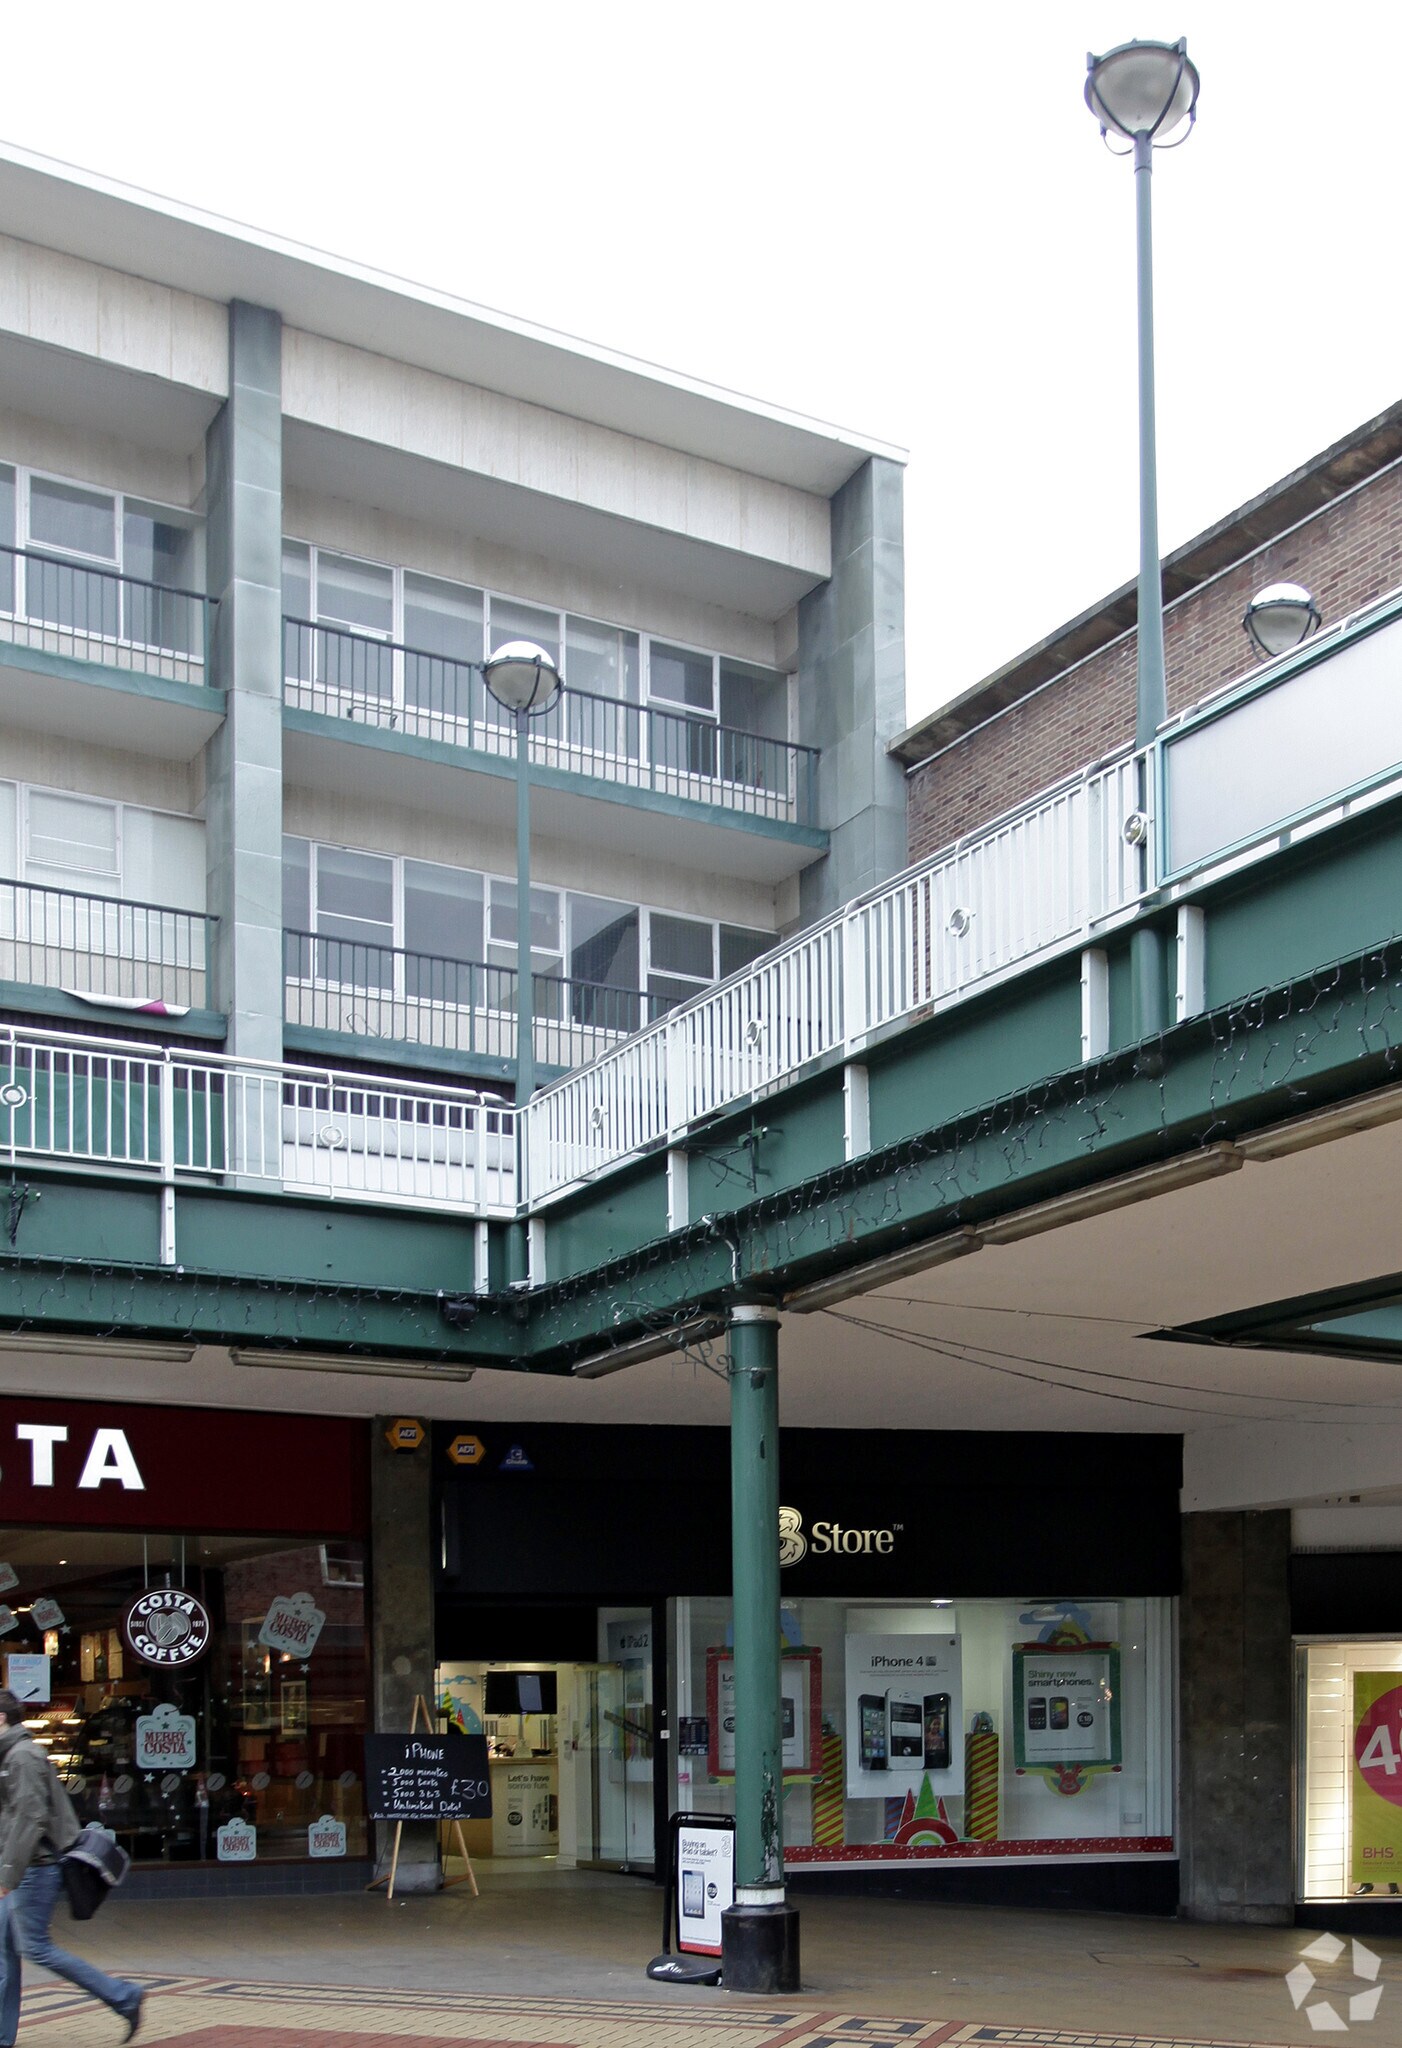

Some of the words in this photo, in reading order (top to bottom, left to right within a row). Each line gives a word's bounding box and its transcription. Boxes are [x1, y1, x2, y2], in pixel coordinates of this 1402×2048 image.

[399, 1428, 417, 1438] ADT
[0, 1424, 146, 1490] TA
[811, 1521, 895, 1554] Store
[138, 1593, 195, 1615] COSTA
[276, 1612, 314, 1632] MERRY
[270, 1621, 308, 1644] COSTA
[135, 1634, 203, 1661] COFFEE
[871, 1655, 913, 1667] iPhone
[915, 1655, 924, 1667] 4
[1028, 1670, 1054, 1679] Shiny
[1028, 1678, 1094, 1688] smartphones.
[144, 1731, 187, 1743] MERRY
[144, 1742, 187, 1756] COSTA
[1359, 1725, 1402, 1775] 4
[387, 1766, 414, 1776] 2000
[451, 1778, 489, 1800] £30
[392, 1799, 433, 1810] Unlimited
[1363, 1847, 1394, 1858] BHS
